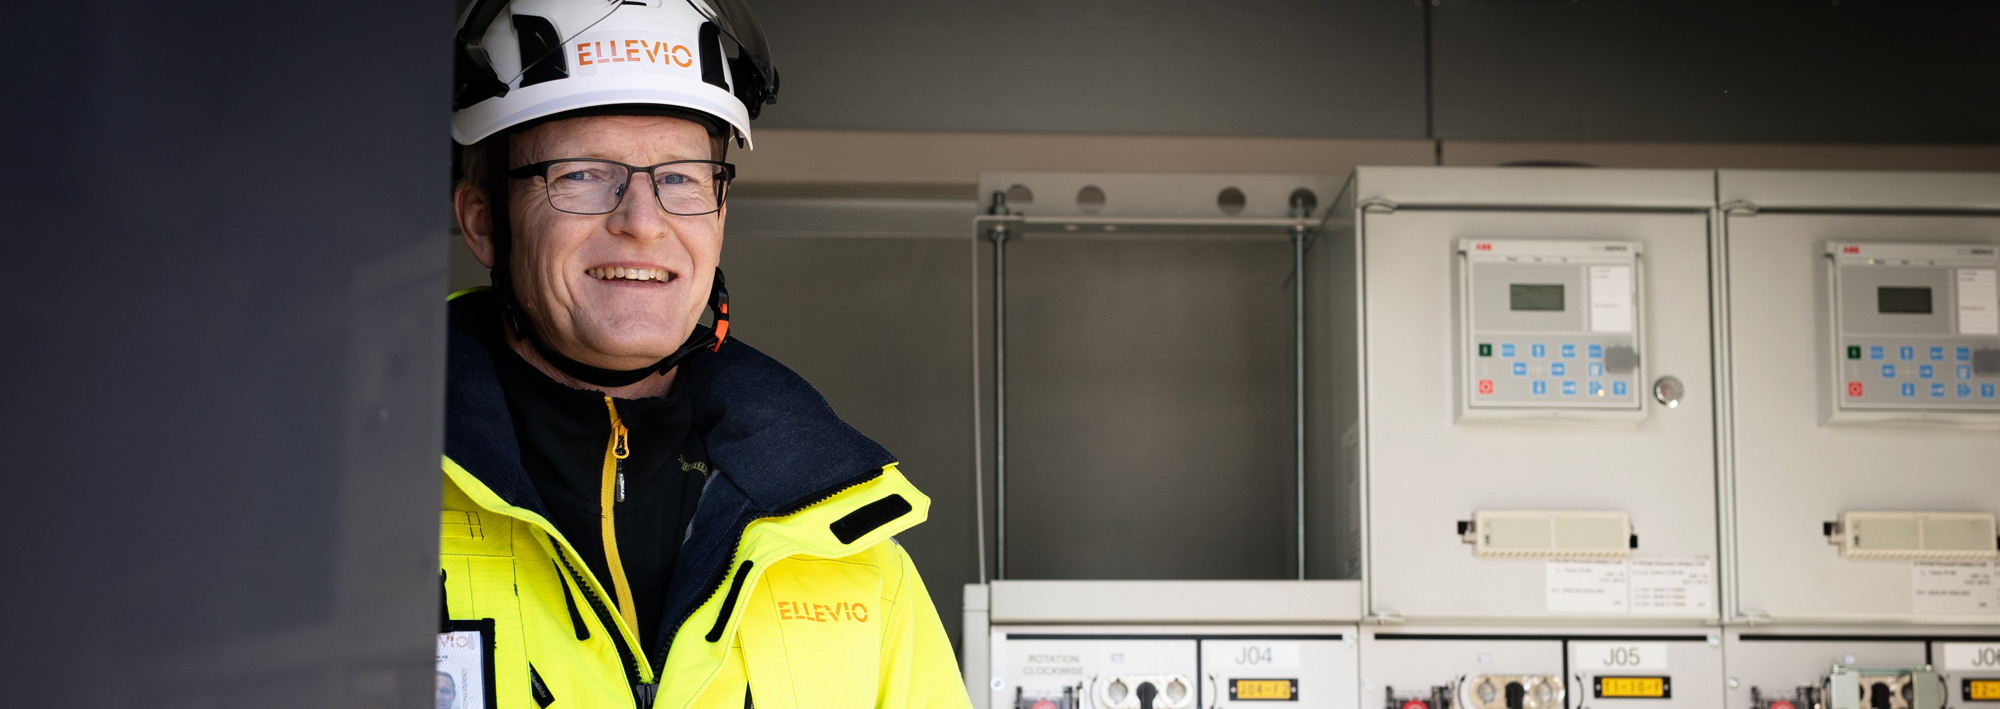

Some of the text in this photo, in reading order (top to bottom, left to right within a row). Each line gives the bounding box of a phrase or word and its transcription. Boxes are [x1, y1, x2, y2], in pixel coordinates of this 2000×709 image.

[577, 39, 693, 68] ELLEVIO
[777, 601, 868, 623] ELLEVIO
[438, 634, 469, 648] VIO
[1027, 654, 1080, 664] ROTATION
[1235, 645, 1273, 665] J04
[1603, 646, 1641, 667] J05
[1022, 665, 1084, 676] CLOCKWISE
